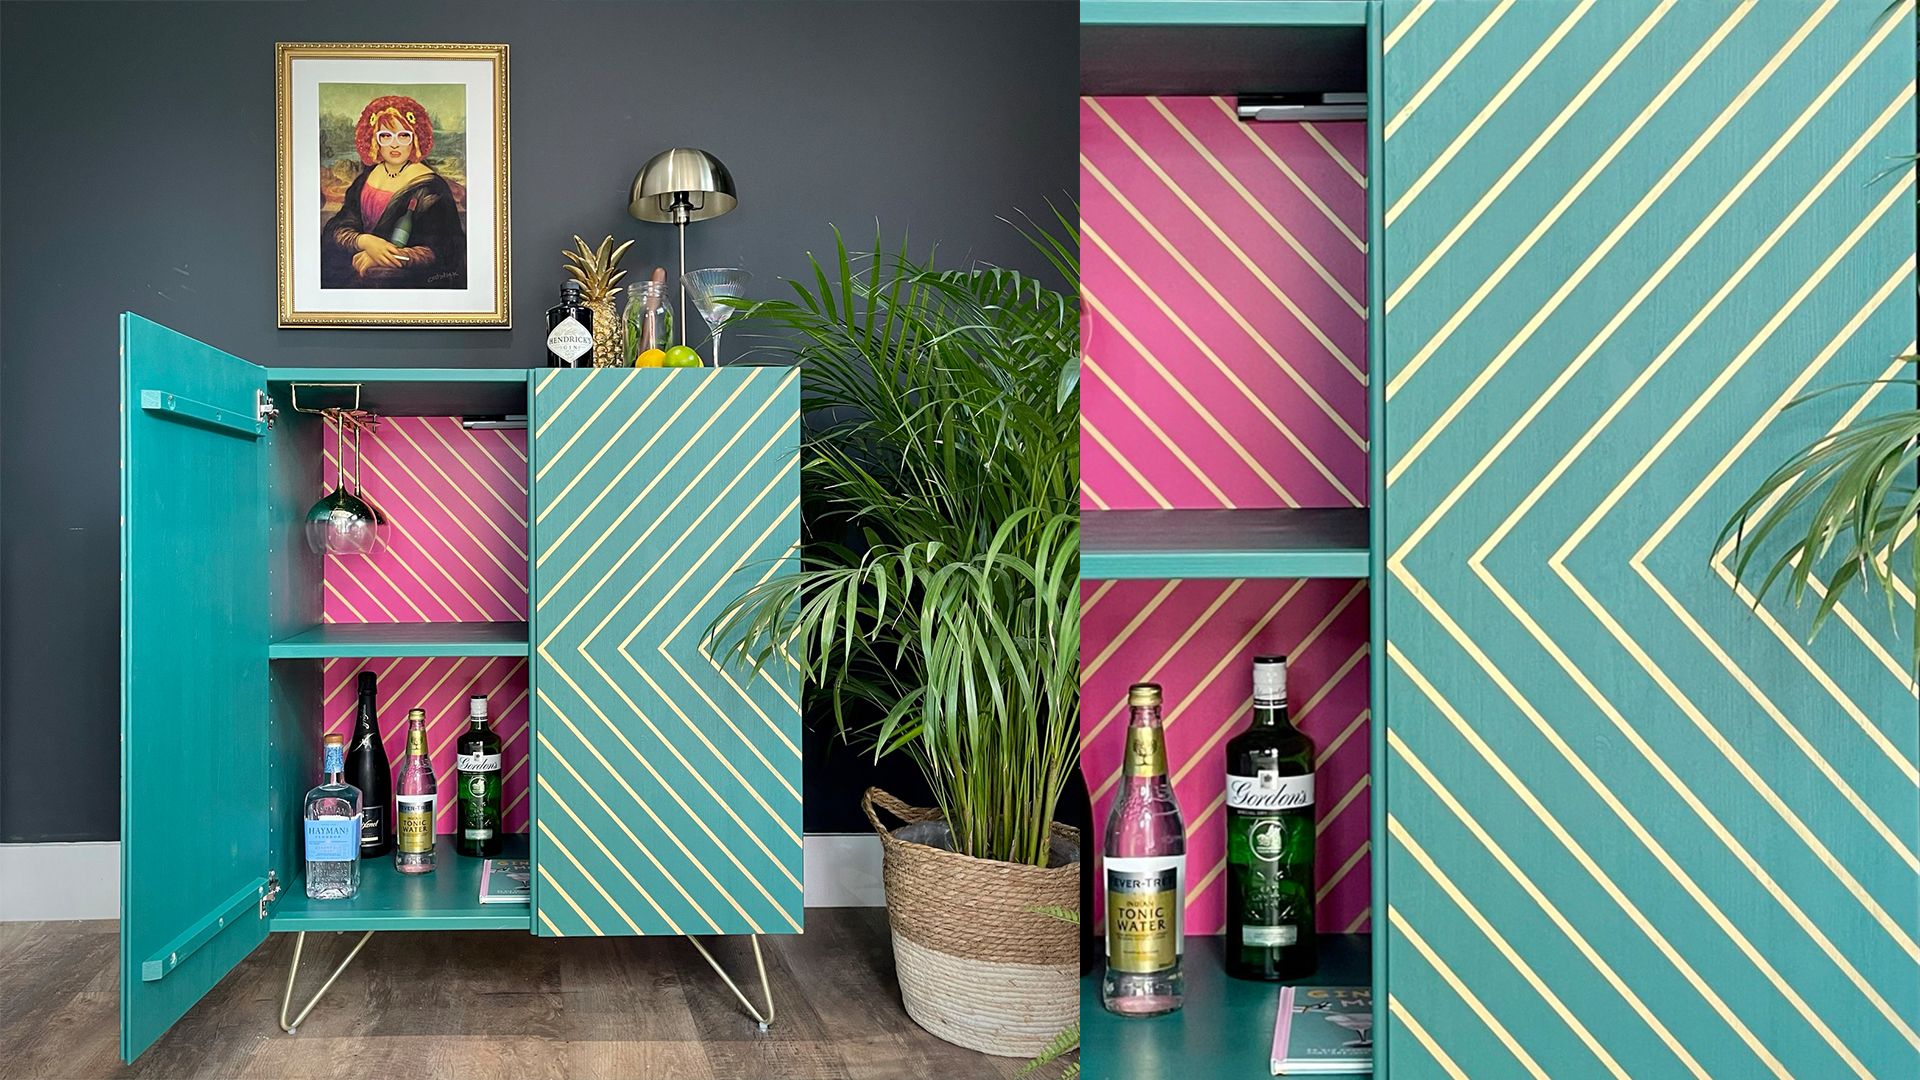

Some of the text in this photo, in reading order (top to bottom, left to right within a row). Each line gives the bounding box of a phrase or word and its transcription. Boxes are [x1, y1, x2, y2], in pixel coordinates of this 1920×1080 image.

[460, 756, 498, 770] Gordon's
[1231, 780, 1307, 807] Gordon's
[1118, 907, 1165, 920] TONIC
[1117, 919, 1166, 932] WATER
